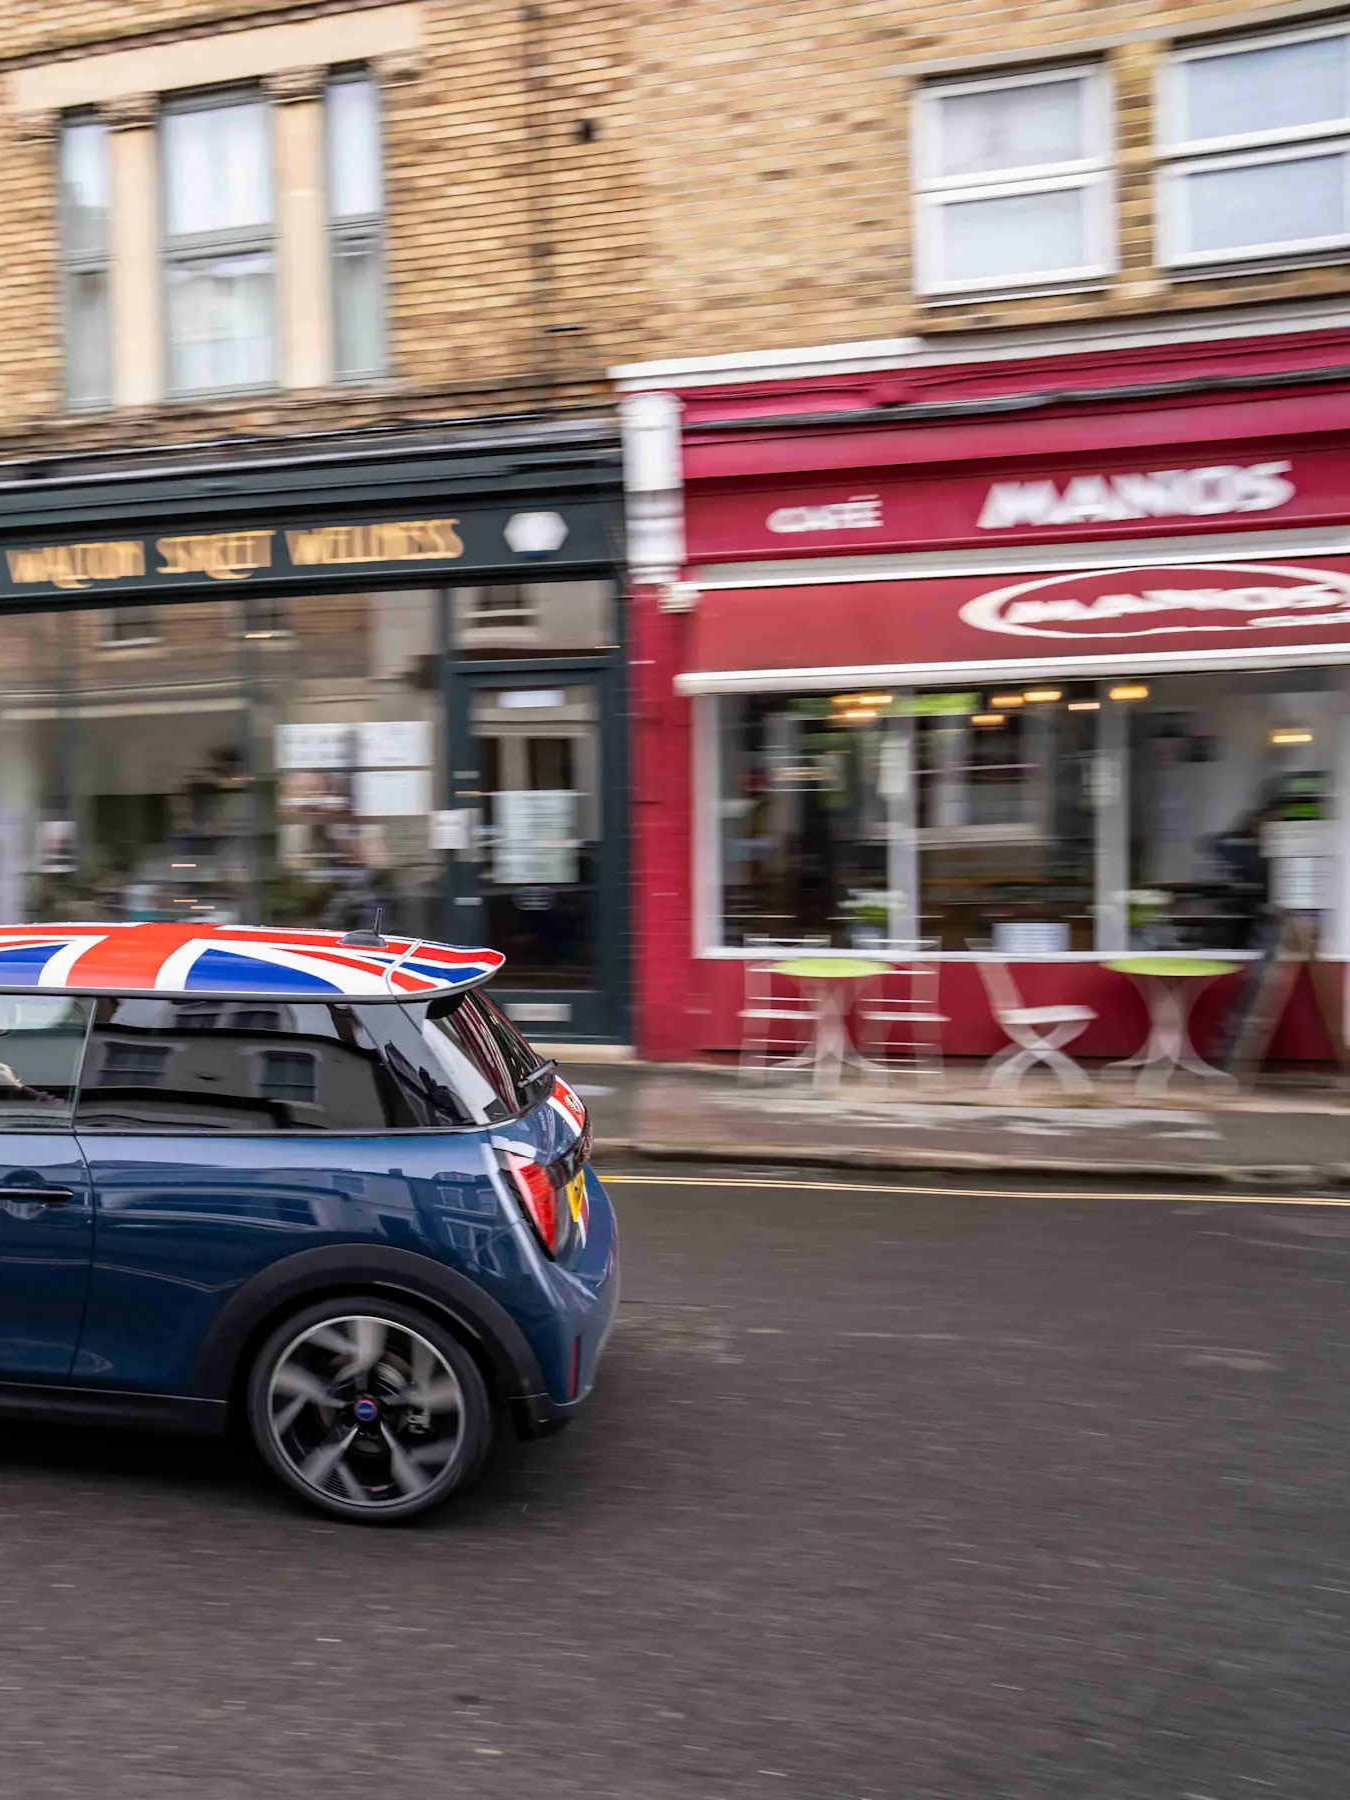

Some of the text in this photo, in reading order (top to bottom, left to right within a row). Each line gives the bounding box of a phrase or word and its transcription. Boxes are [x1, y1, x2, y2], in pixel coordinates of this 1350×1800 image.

[766, 460, 1297, 534] CAFÉ MANOS
[284, 518, 465, 567] WELLNESS
